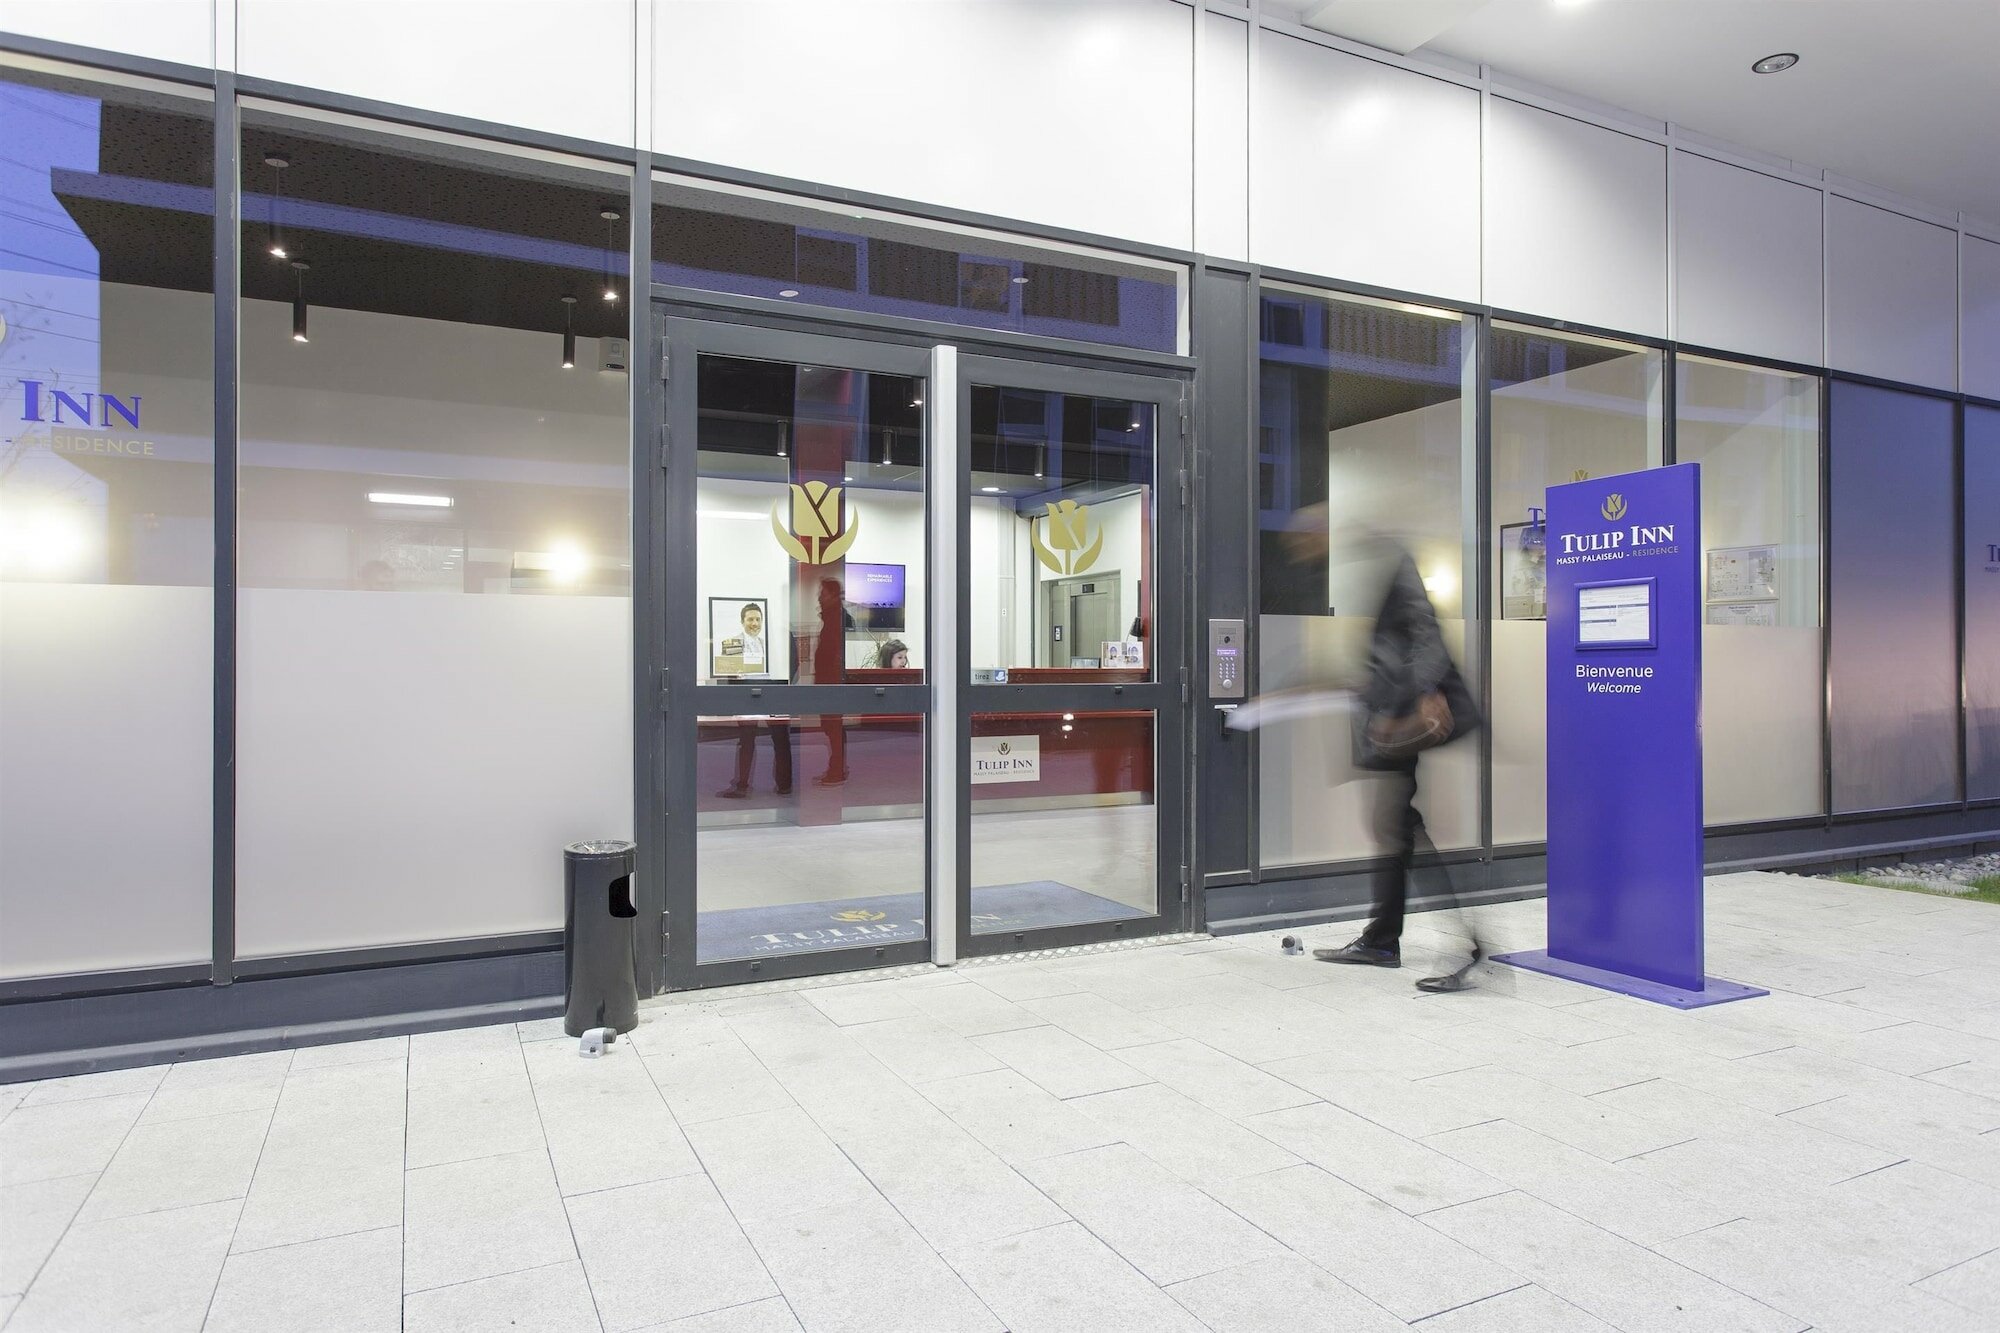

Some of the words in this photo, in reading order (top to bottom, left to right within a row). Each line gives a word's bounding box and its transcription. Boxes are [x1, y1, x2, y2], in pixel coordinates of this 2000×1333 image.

[18, 380, 142, 429] INN
[1560, 531, 1624, 553] TULIP
[1630, 524, 1675, 546] INN
[1556, 556, 1580, 565] MASSY
[1582, 551, 1624, 563] PALAISEAU
[1632, 545, 1679, 557] RESIDENCE
[975, 672, 990, 680] tirez
[1576, 664, 1653, 678] Bienvenue
[1587, 682, 1642, 693] Welcome
[976, 760, 1009, 770] TULIP
[1012, 758, 1033, 769] INN
[750, 923, 898, 944] TULIP
[822, 930, 915, 944] PALAISEAU
